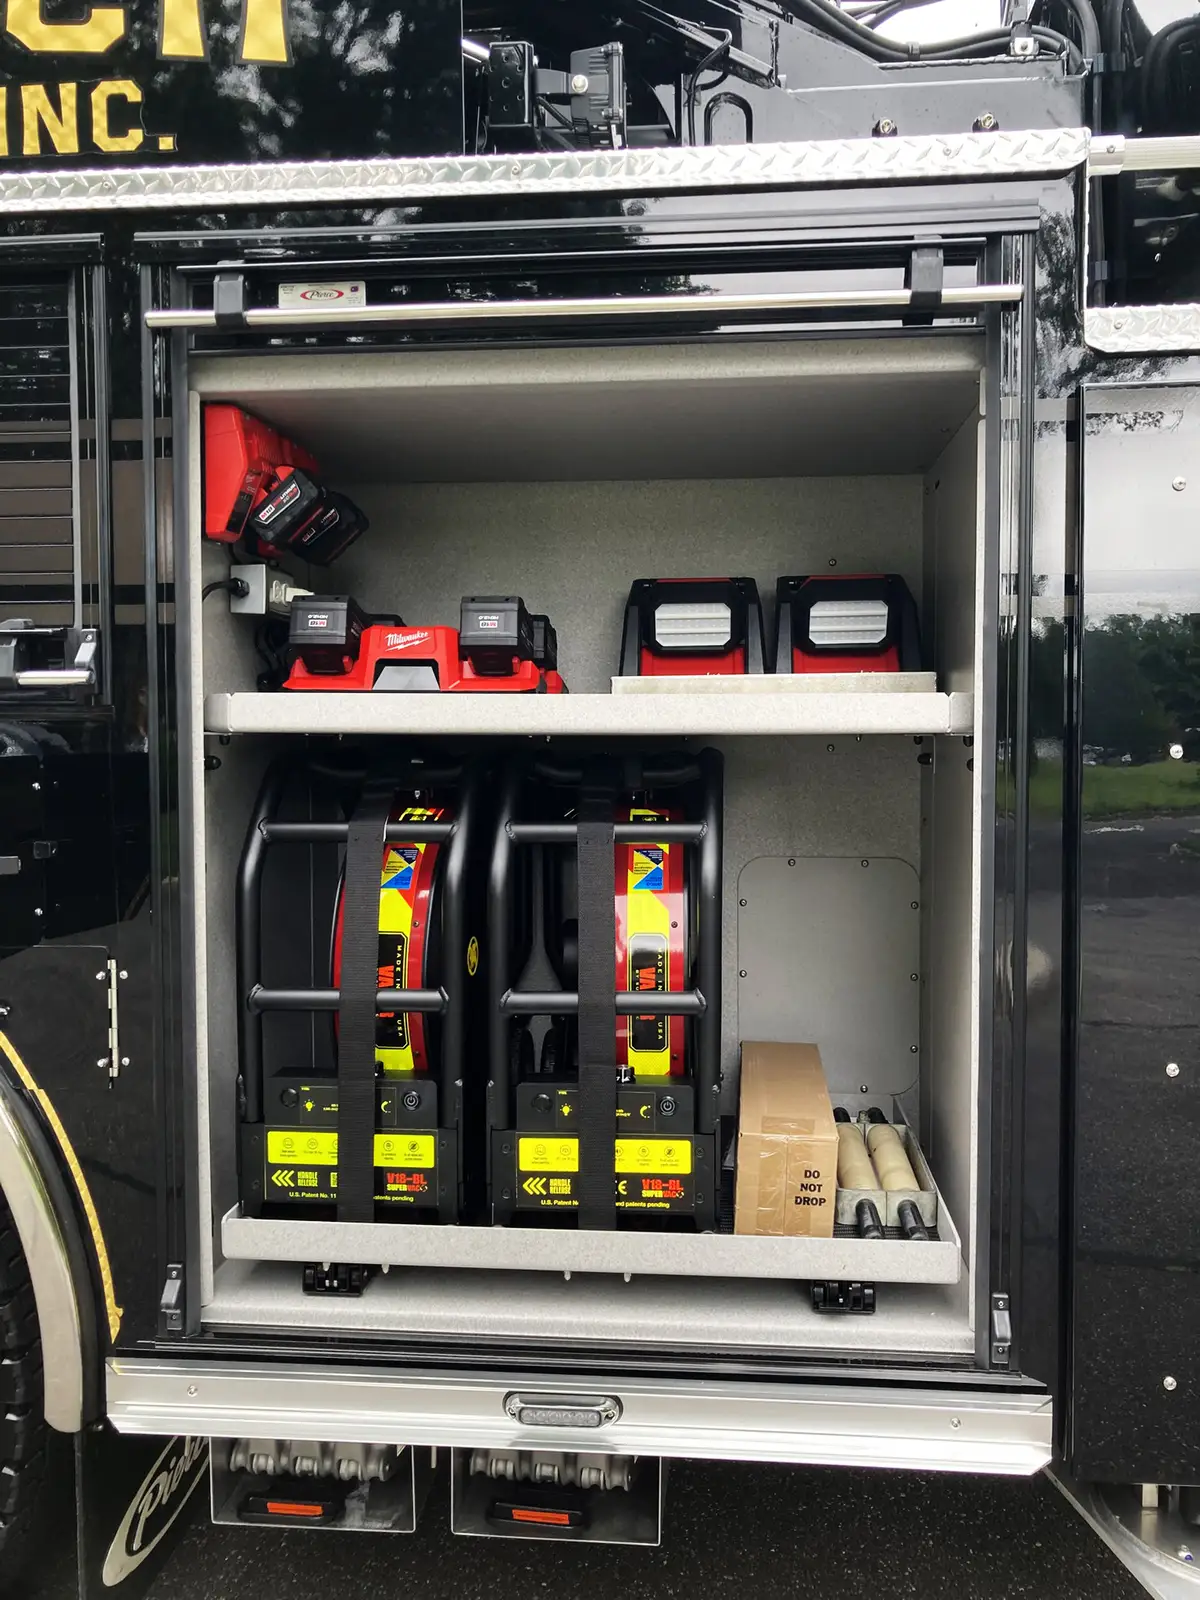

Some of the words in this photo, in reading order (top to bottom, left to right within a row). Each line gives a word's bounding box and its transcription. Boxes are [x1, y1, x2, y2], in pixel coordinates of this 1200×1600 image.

[310, 289, 335, 299] Pierce
[384, 630, 429, 647] Milwaukee
[396, 1019, 404, 1037] USA
[804, 1169, 821, 1179] DO
[800, 1182, 823, 1193] NOT
[301, 1191, 319, 1199] Patent
[794, 1195, 827, 1207] DROP
